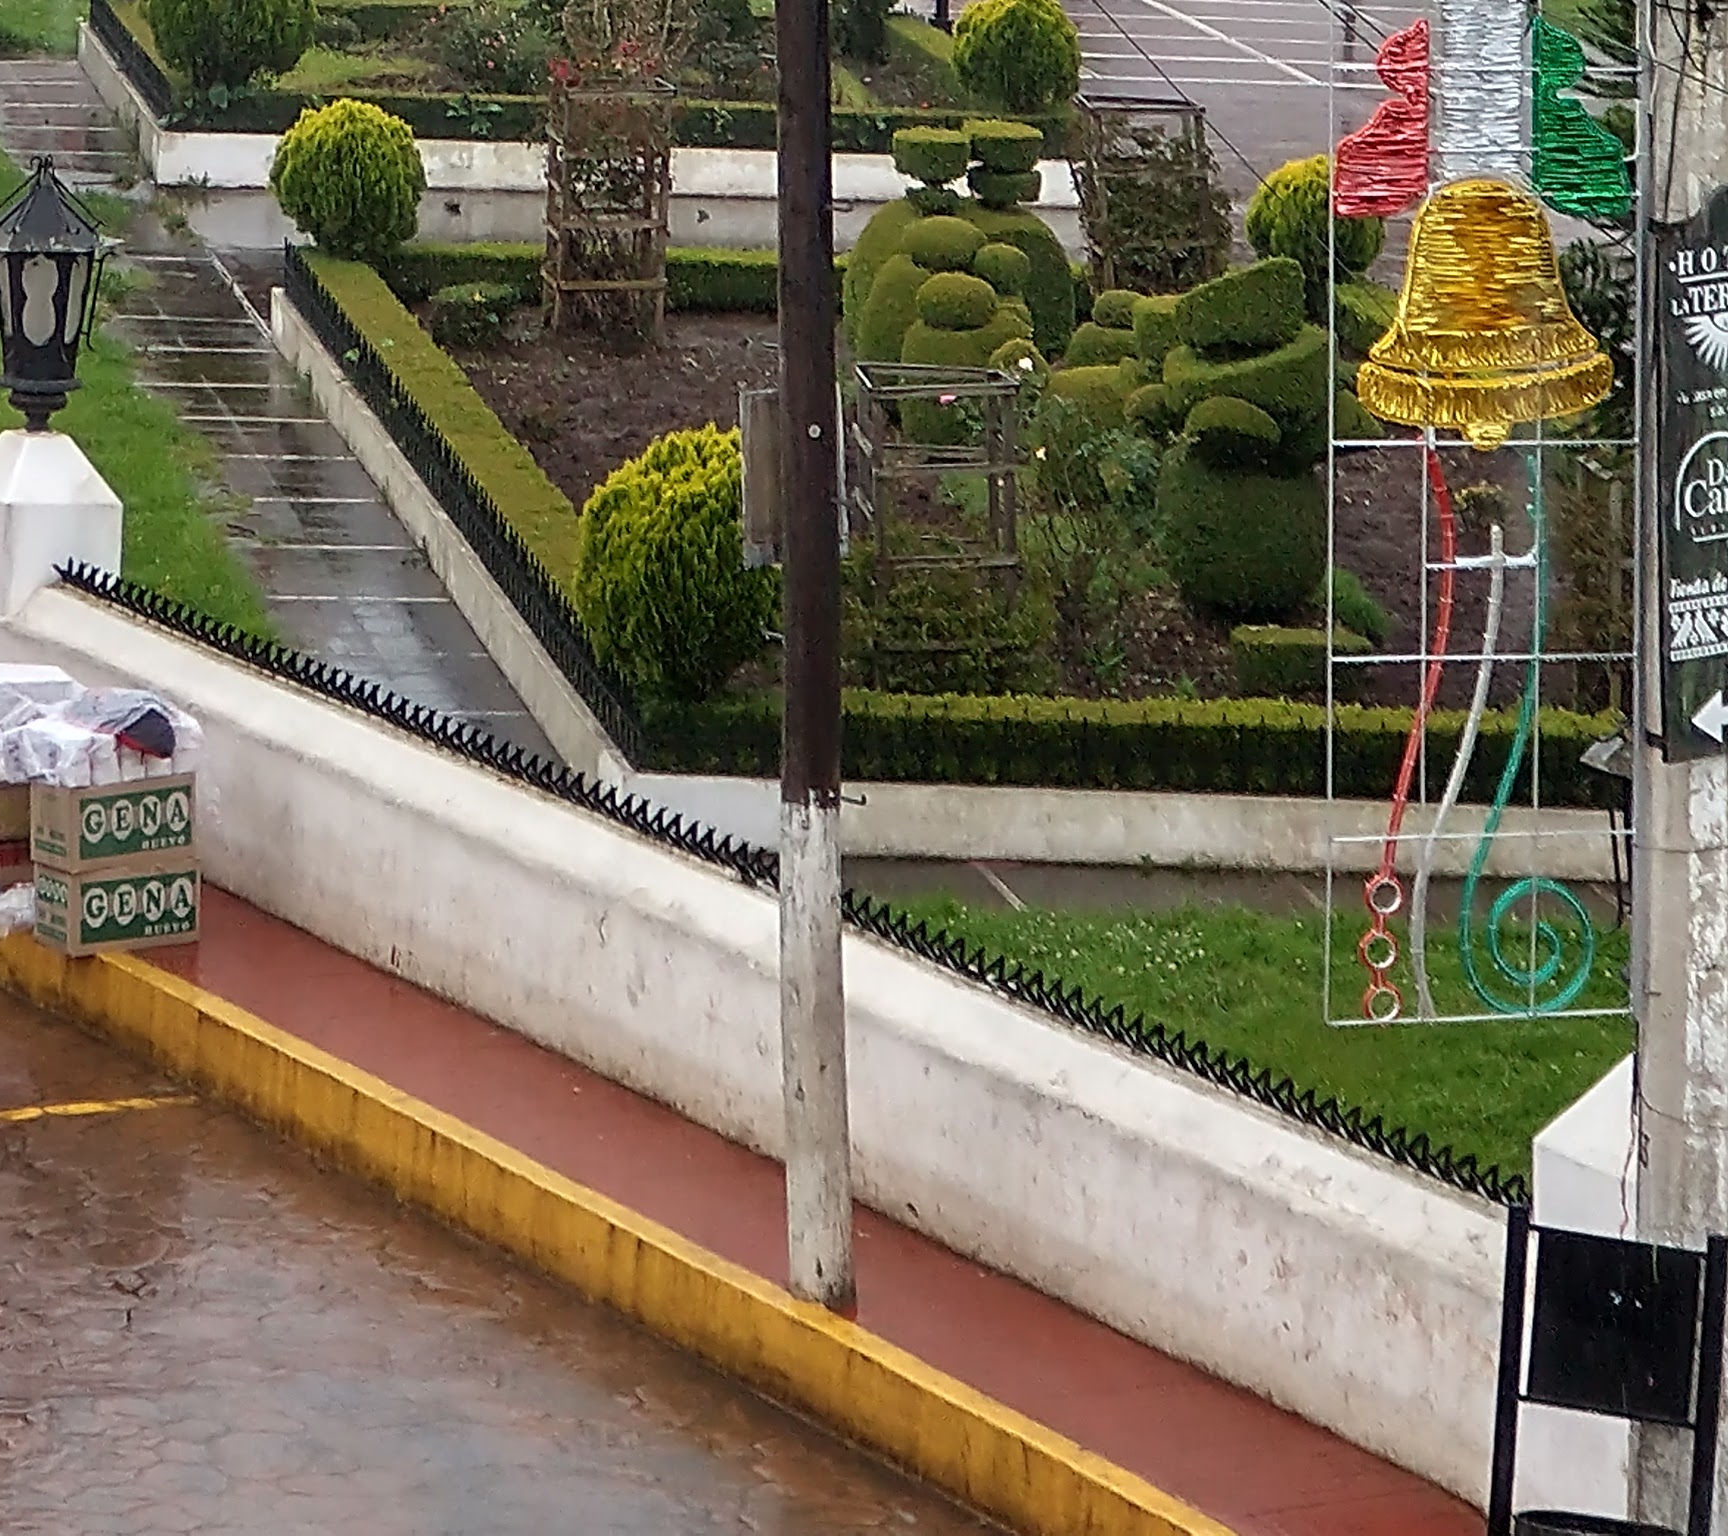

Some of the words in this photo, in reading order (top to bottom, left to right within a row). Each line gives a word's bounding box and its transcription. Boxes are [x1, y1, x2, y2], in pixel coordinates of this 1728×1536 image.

[1676, 245, 1728, 277] HO
[1671, 299, 1690, 317] LA
[1707, 458, 1728, 487] D
[1684, 480, 1728, 518] Ca
[1670, 577, 1709, 599] Tienda
[83, 796, 188, 835] GENA
[84, 883, 192, 919] GENA
